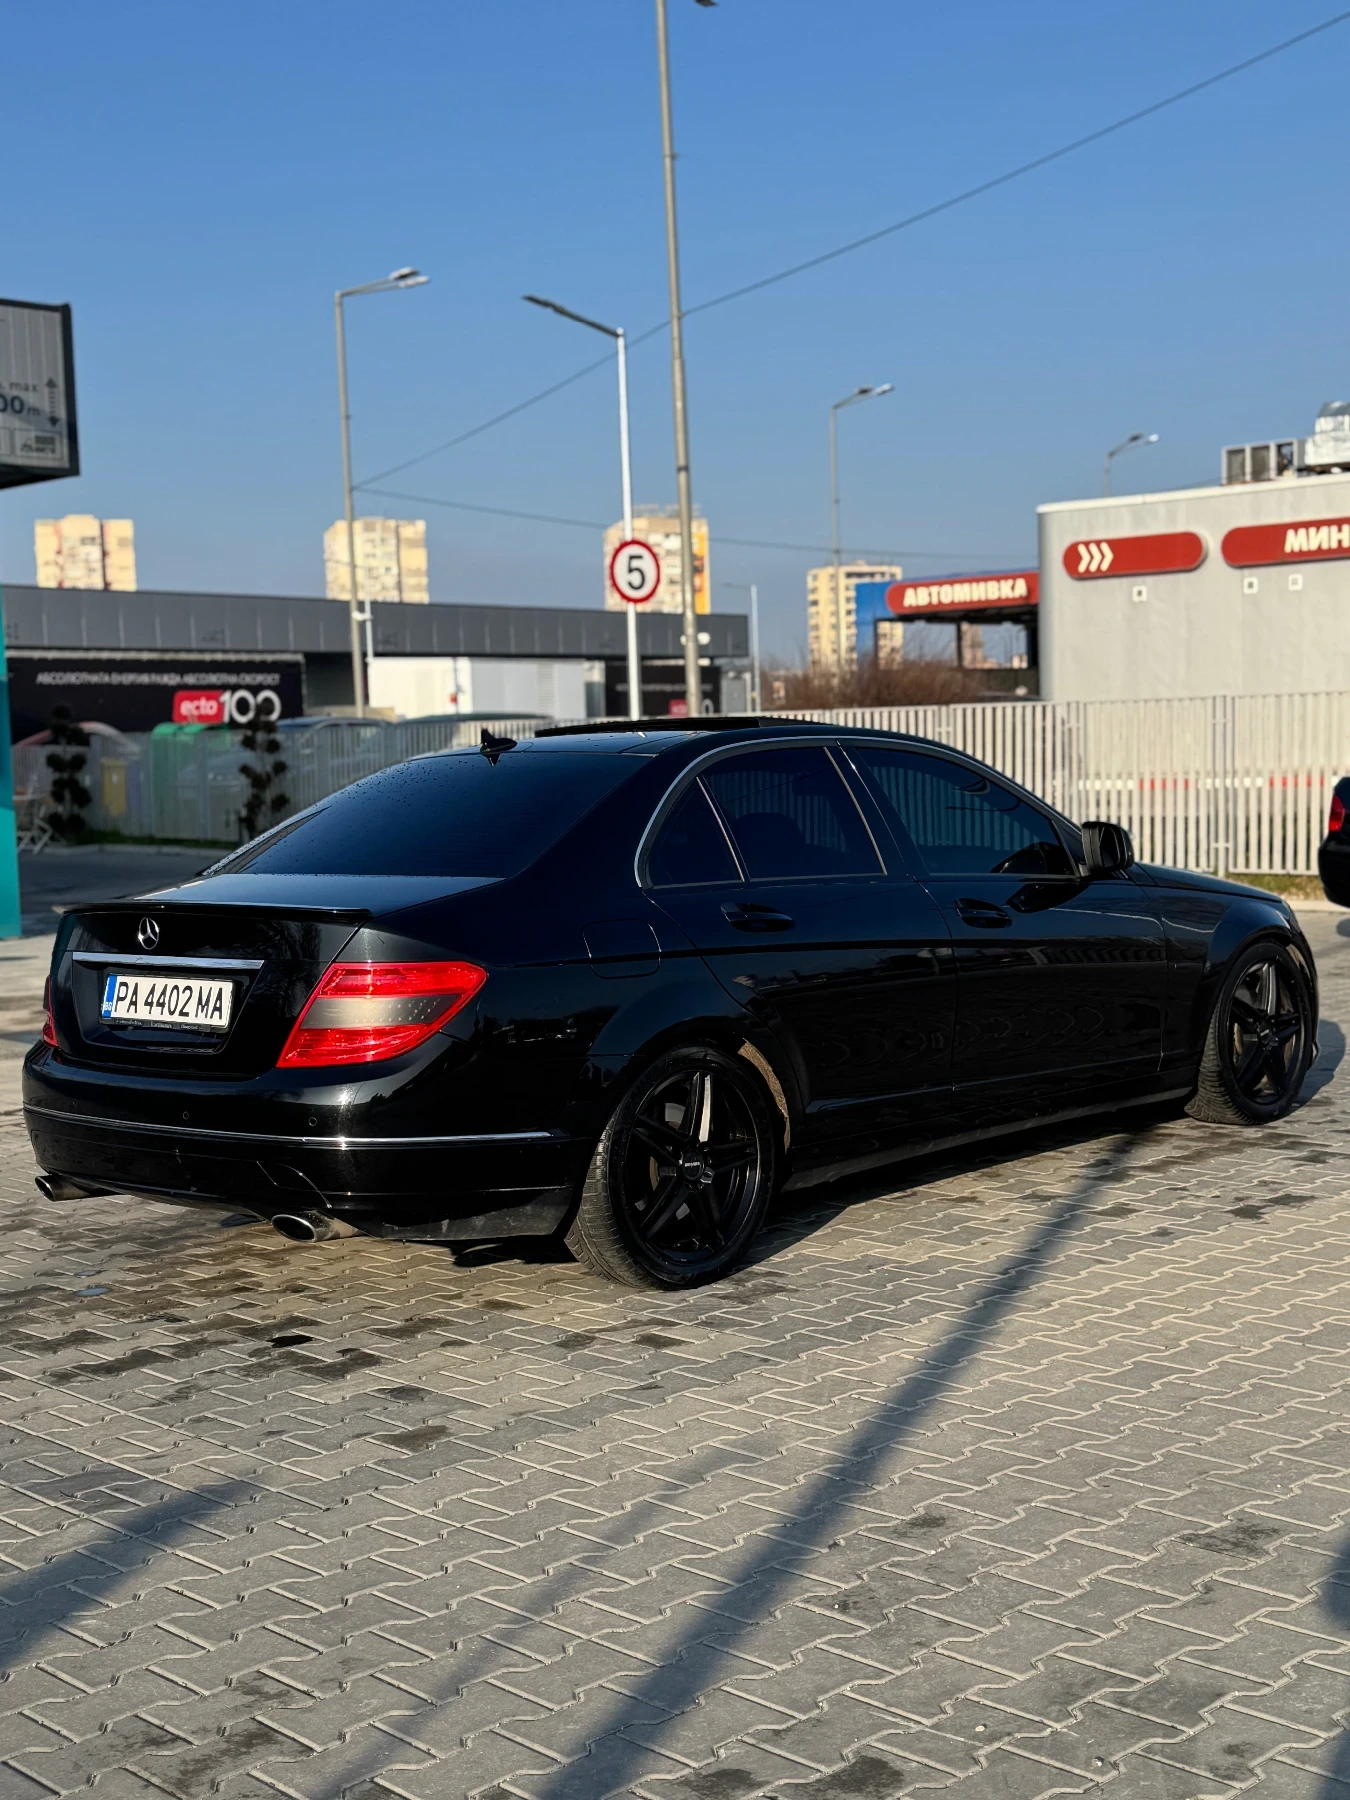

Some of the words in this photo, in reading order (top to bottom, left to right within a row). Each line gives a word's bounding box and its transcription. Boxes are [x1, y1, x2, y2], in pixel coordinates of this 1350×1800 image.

[627, 555, 646, 590] 5
[903, 577, 1028, 608] АВТОМИВКА
[114, 981, 138, 1014] PA
[143, 983, 194, 1018] 4402
[195, 985, 223, 1020] MA
